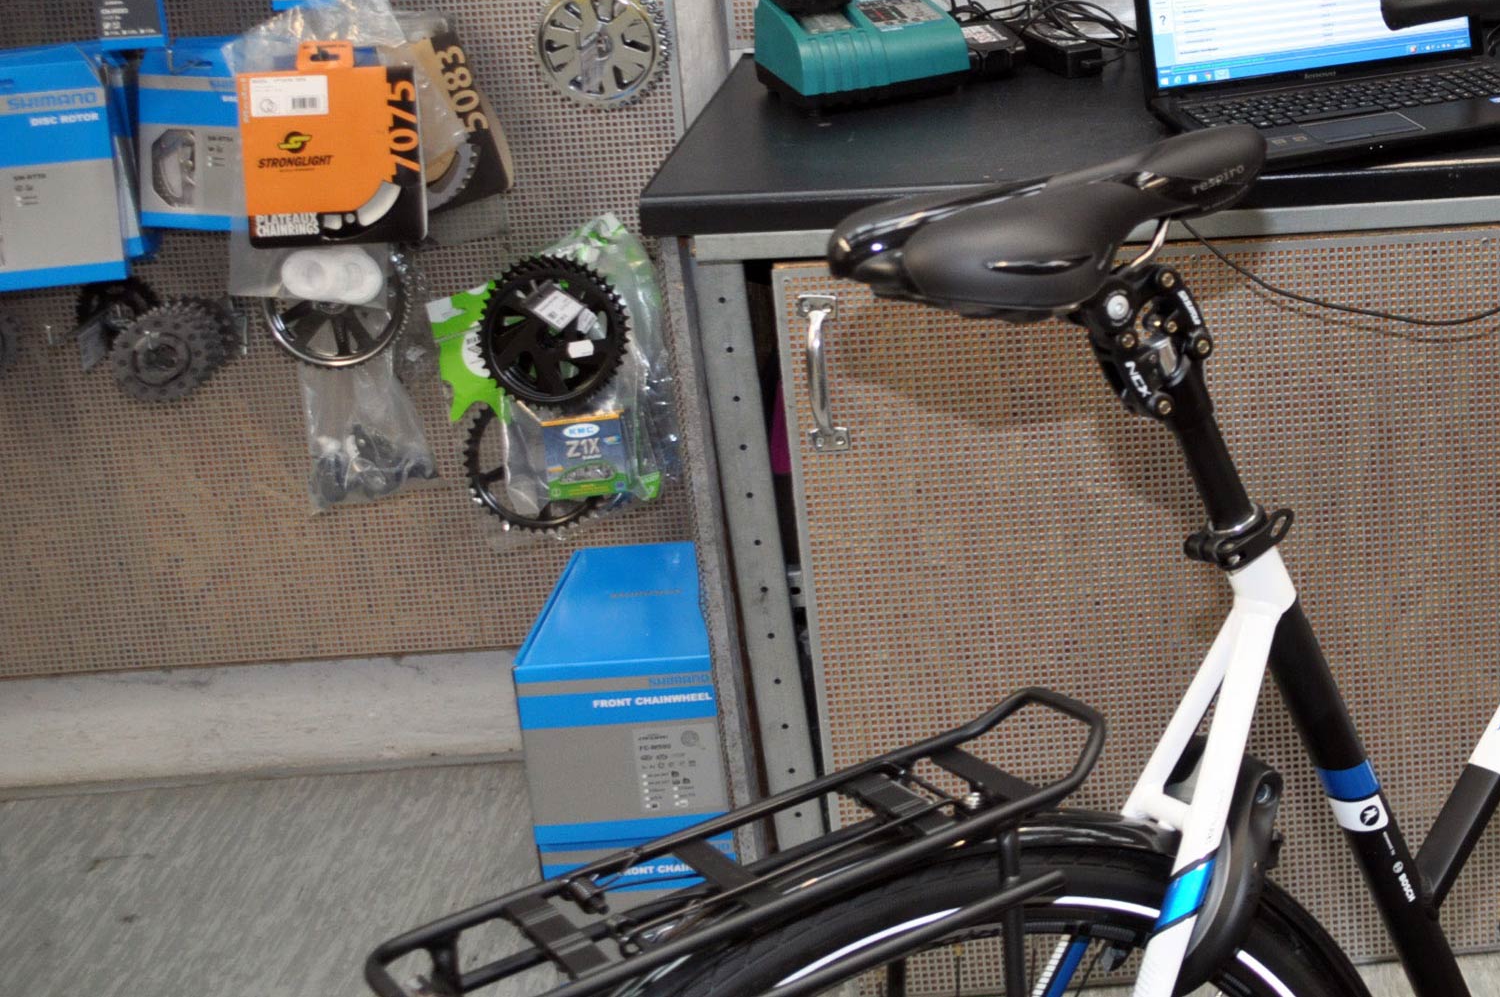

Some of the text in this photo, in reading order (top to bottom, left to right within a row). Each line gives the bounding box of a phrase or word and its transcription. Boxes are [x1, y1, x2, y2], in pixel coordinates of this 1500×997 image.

[7, 91, 99, 110] SHIMANO
[30, 112, 100, 127] DISC ROTOR
[387, 80, 422, 173] 7075
[257, 154, 335, 169] STRONGLIGHT
[1191, 164, 1246, 194] respiro
[255, 212, 319, 226] PLATEAUX
[255, 223, 321, 238] CHAINRINGS
[1125, 360, 1152, 398] NCX
[592, 691, 713, 709] FRONT CHAINWHEEL
[619, 865, 655, 877] RONT
[1398, 871, 1417, 903] BOSCH
